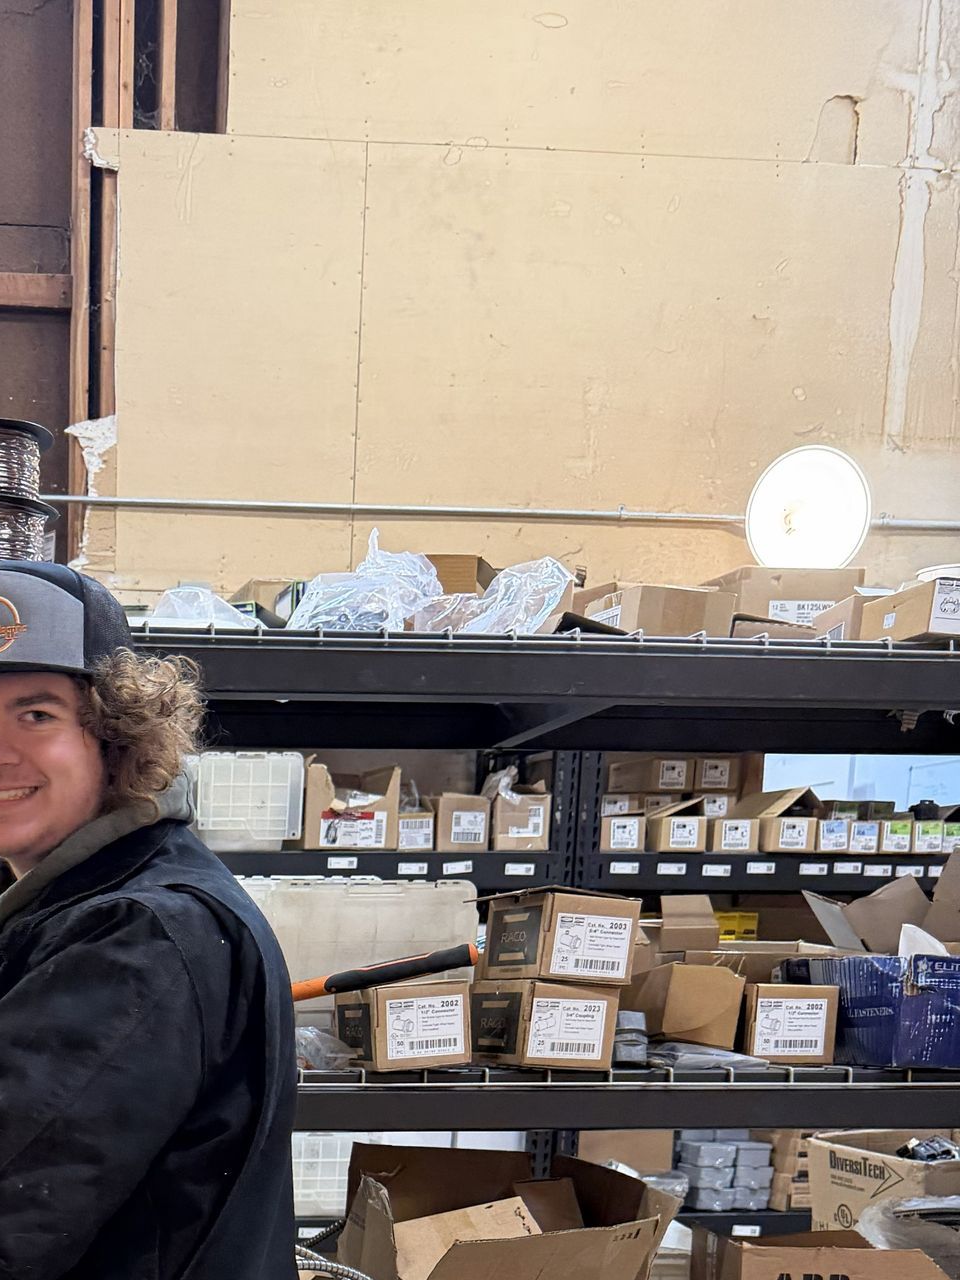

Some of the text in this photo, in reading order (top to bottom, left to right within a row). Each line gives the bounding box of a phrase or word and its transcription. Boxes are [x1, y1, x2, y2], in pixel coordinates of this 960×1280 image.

[609, 922, 627, 930] 2003
[500, 931, 527, 944] RACO
[440, 999, 459, 1008] 2002
[583, 1004, 601, 1012] 2023
